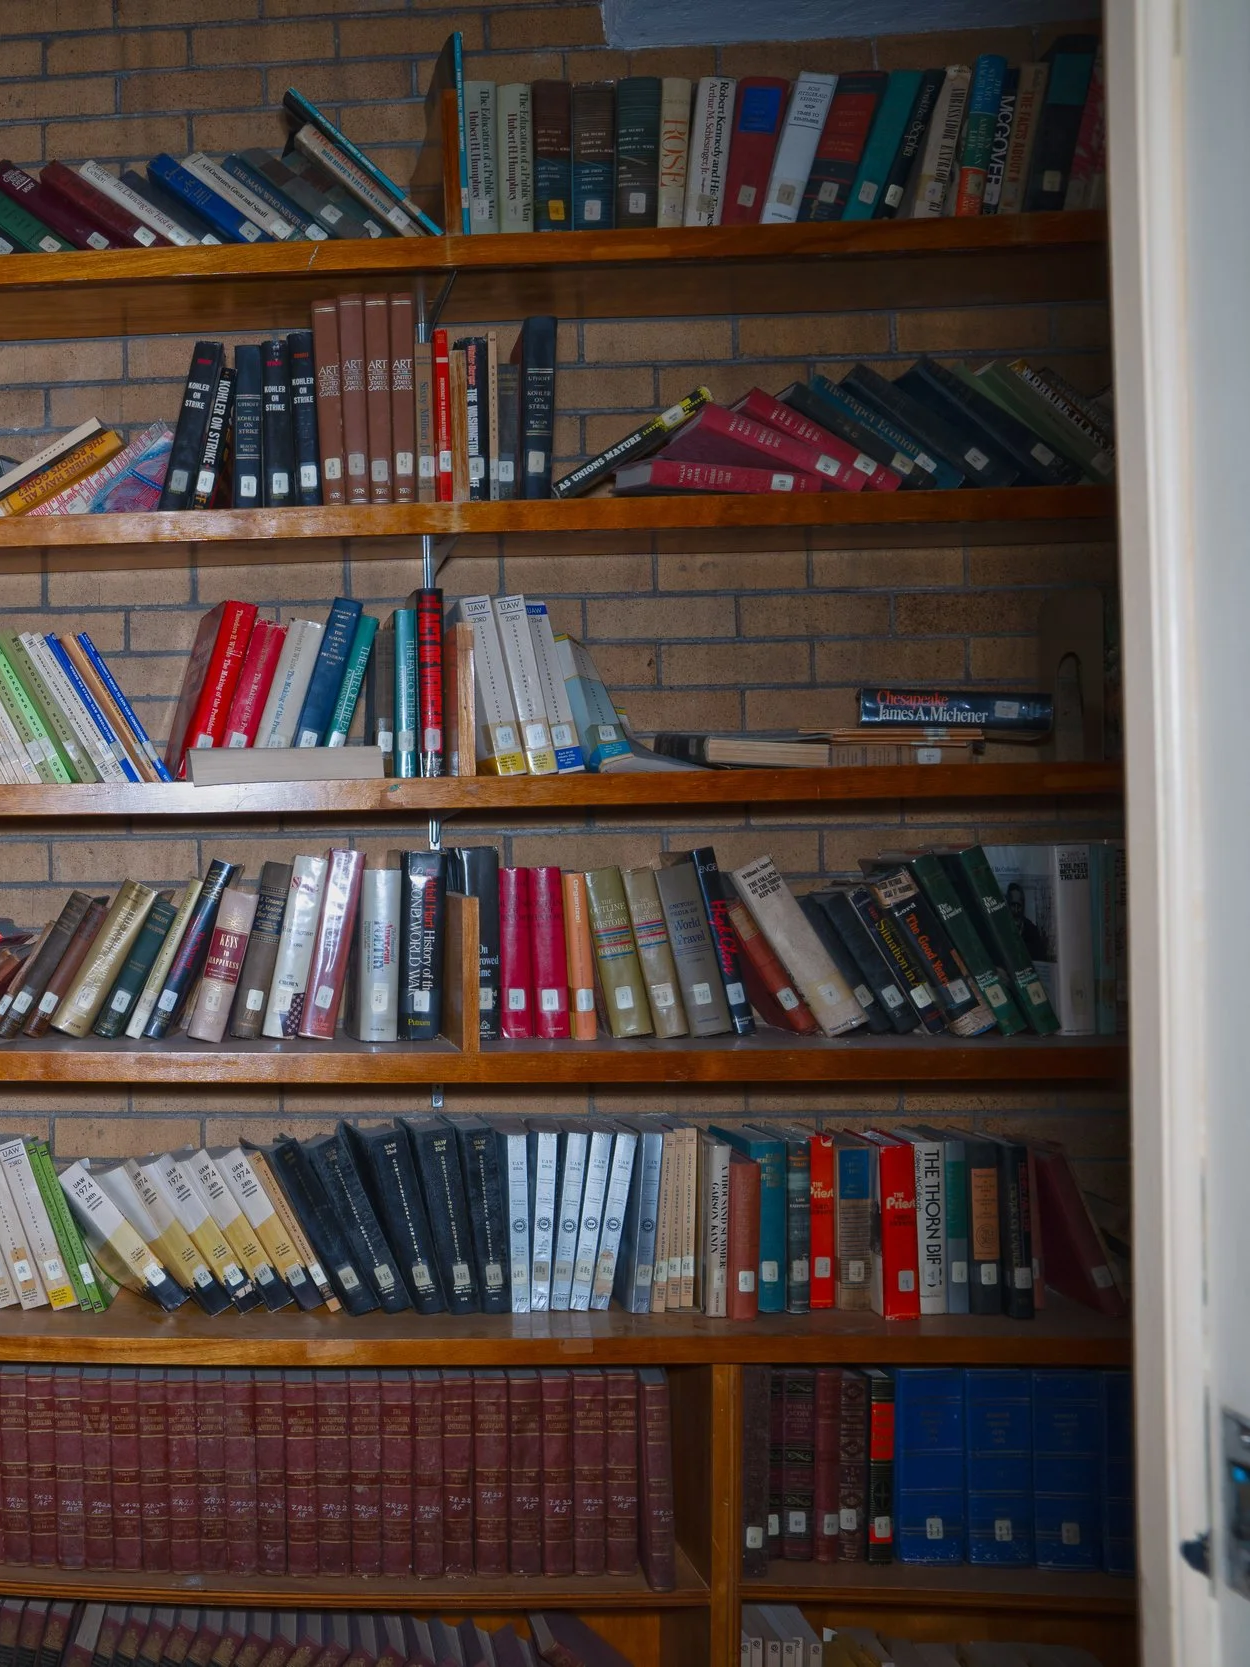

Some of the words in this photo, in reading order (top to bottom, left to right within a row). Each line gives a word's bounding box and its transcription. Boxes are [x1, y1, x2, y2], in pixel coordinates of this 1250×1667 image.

[479, 89, 489, 106] The
[518, 92, 528, 109] The
[706, 82, 718, 110] Arthur
[717, 81, 729, 115] Robert
[1020, 90, 1034, 109] THE
[705, 110, 715, 121] M.
[941, 86, 966, 141] AMBASSADOR
[468, 110, 479, 141] Hubert
[480, 108, 492, 150] Education
[507, 113, 517, 143] Hubert
[518, 110, 529, 153] Education
[1014, 110, 1030, 140] FACTS
[700, 122, 714, 166] Schlesinger,
[711, 115, 726, 159] Kennedy
[470, 142, 479, 152] H.
[482, 151, 492, 160] of
[508, 145, 517, 154] H.
[660, 119, 687, 187] ROSE
[520, 155, 529, 163] of
[1008, 141, 1025, 172] ABOUT
[469, 153, 480, 198] Humphrey
[699, 166, 709, 174] Jr.
[711, 159, 720, 178] and
[483, 169, 494, 196] Public
[506, 156, 517, 200] Humphrey
[520, 172, 531, 200] Public
[709, 179, 719, 195] His
[232, 166, 247, 181] THE
[244, 177, 264, 195] MAN
[261, 191, 281, 209] WHO
[278, 205, 301, 226] NEVER
[521, 203, 531, 221] Man
[318, 365, 338, 376] ART
[343, 359, 362, 370] ART
[368, 359, 388, 370] ART
[393, 359, 413, 369] ART
[188, 381, 210, 392] KOHLER
[264, 385, 286, 393] KOHLER
[292, 377, 314, 385] KOHLER
[193, 392, 201, 400] ON
[213, 379, 231, 416] KOHLER
[299, 386, 308, 394] ON
[185, 400, 205, 409] STRIKE
[294, 394, 314, 404] STRIKE
[265, 404, 285, 412] STRIKE
[211, 417, 223, 433] ON
[86, 434, 106, 451] THE
[203, 431, 220, 466] STRIKE
[48, 446, 87, 476] ROBOTS
[62, 450, 97, 478] WHERE
[557, 478, 571, 491] AS
[569, 455, 605, 483] UNIONS
[602, 431, 642, 462] MATURE
[15, 471, 50, 498] GONE?
[37, 472, 64, 494] HAVE
[21, 489, 38, 505] ALL
[468, 603, 486, 612] UAW
[231, 608, 243, 634] Theodore
[419, 612, 440, 642] ACT
[419, 645, 440, 663] OF
[222, 658, 230, 670] The
[215, 669, 228, 691] Making
[212, 698, 220, 708] the
[876, 690, 949, 707] Chesapeake
[205, 707, 218, 735] President
[877, 704, 914, 722] James
[915, 705, 929, 722] A.
[929, 706, 988, 723] Michener
[590, 903, 626, 915] OUTLINE
[630, 901, 660, 914] OUTLINE
[895, 902, 916, 918] Lord
[425, 906, 436, 928] Hart
[593, 918, 628, 928] HISTORY
[633, 912, 662, 922] HISTORY
[673, 920, 701, 931] World
[220, 934, 239, 949] KEYS
[408, 923, 422, 967] WORLD
[674, 933, 706, 945] Travel
[424, 930, 436, 967] History
[479, 943, 489, 954] On
[876, 919, 907, 969] Situation
[905, 968, 918, 983] in
[904, 912, 922, 935] The
[916, 933, 937, 961] Good
[930, 959, 952, 988] Years
[209, 956, 240, 969] HAPPINESS
[422, 968, 432, 980] of
[408, 1018, 430, 1026] Putnam
[924, 1149, 939, 1178] THE
[135, 1177, 148, 1190] 1974
[168, 1174, 183, 1187] 1974
[200, 1170, 217, 1184] 1974
[233, 1168, 251, 1182] 1974
[75, 1182, 94, 1198] 1974
[208, 1181, 219, 1191] 24th
[241, 1180, 252, 1189] 24th
[811, 1187, 834, 1198] Priest
[85, 1192, 97, 1203] 24th
[709, 1182, 720, 1220] GARSON
[718, 1174, 730, 1224] THOUSAND
[886, 1197, 915, 1211] Priest
[924, 1182, 941, 1239] THORN
[709, 1224, 719, 1253] KANIN
